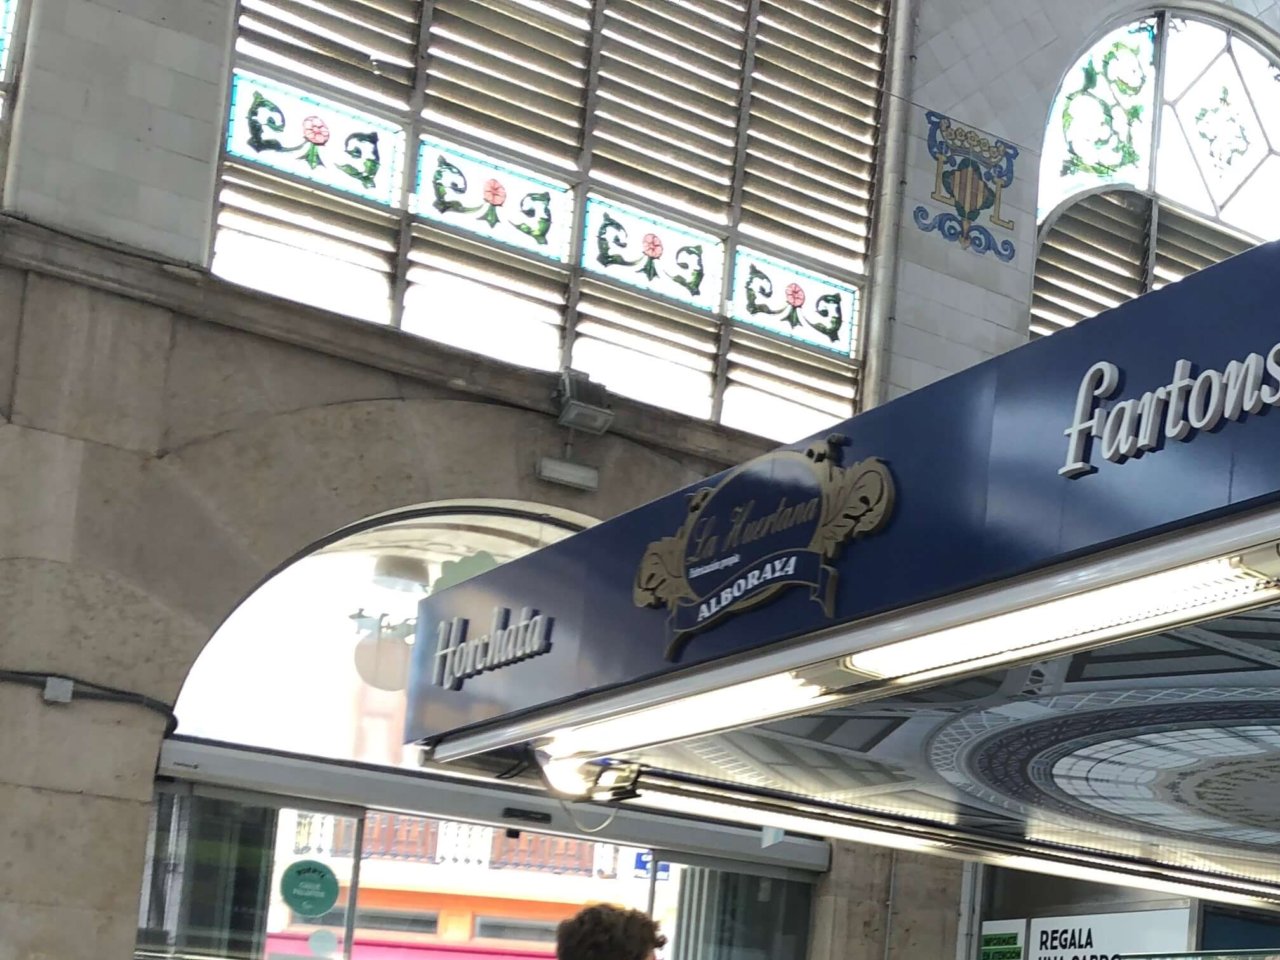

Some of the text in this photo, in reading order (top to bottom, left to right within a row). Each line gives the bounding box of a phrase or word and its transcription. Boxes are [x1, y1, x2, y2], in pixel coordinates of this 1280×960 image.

[697, 556, 798, 621] ALBORAYA
[430, 607, 553, 690] Horchata
[1039, 928, 1094, 950] REGALA
